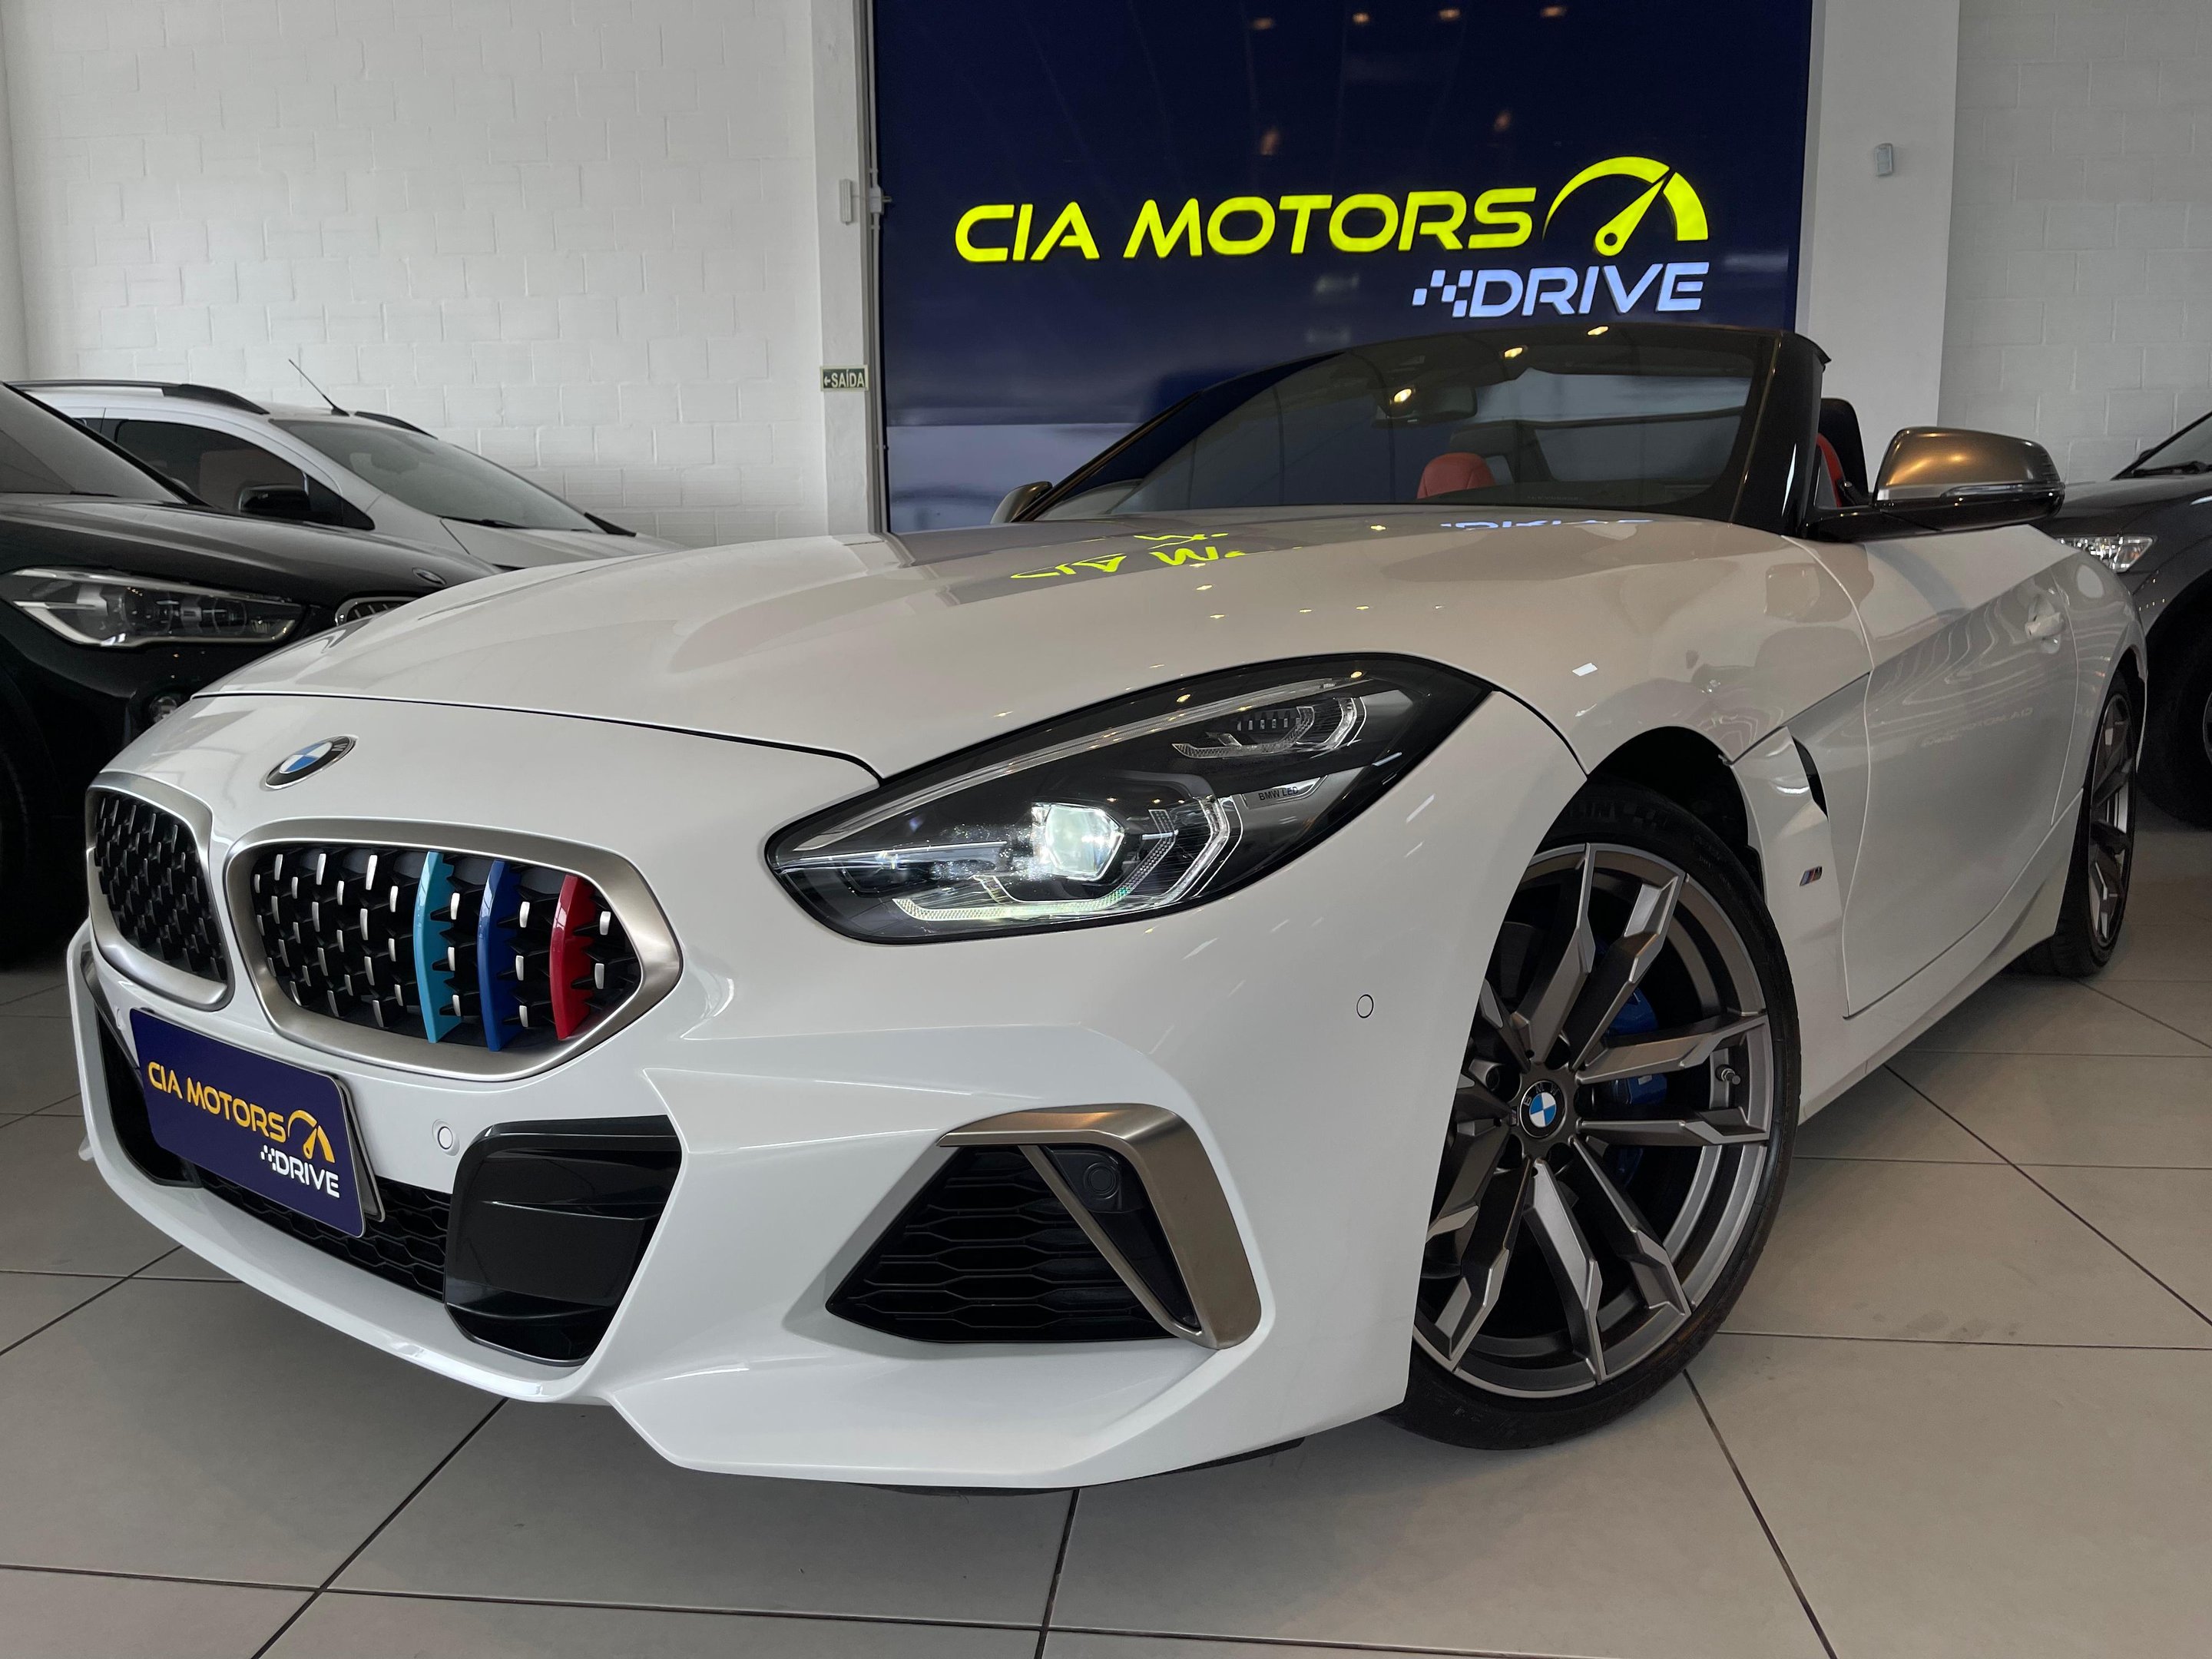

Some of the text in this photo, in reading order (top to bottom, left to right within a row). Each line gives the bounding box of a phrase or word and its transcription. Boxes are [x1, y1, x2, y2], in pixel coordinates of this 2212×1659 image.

[955, 187, 1537, 262] CIA MOTORS
[1468, 262, 1710, 318] DRIVE
[831, 369, 865, 388] SAÍDA
[1258, 786, 1299, 800] BMW LED
[147, 1061, 286, 1143] CIA MOTORS
[1523, 1082, 1561, 1107] BMW
[272, 1150, 340, 1198] DRIVE
